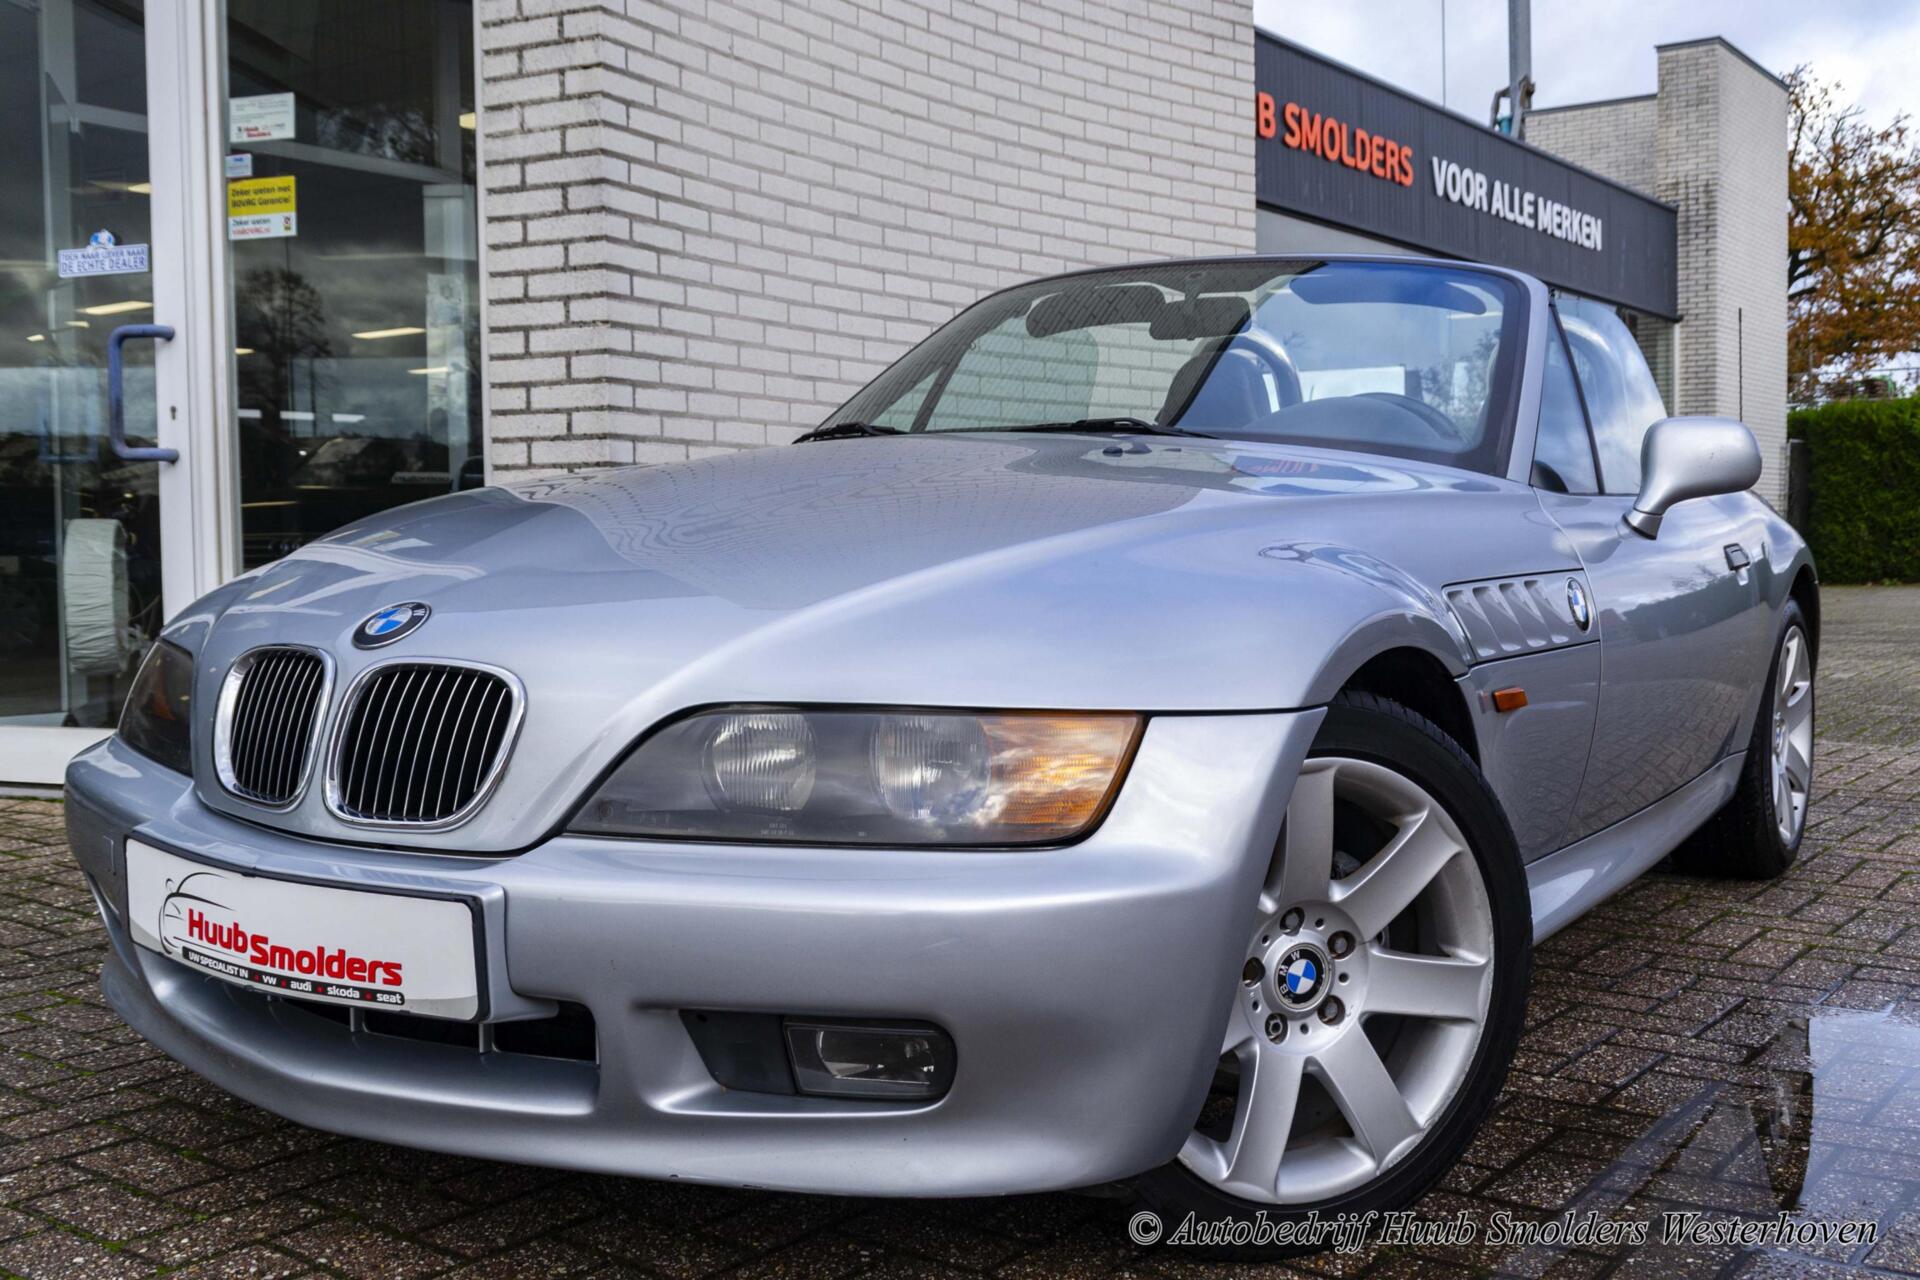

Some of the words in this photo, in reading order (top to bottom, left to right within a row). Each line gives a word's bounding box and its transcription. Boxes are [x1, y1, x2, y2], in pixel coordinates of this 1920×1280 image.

[1283, 101, 1414, 187] SMOLDERS
[1431, 155, 1489, 212] VOOR
[1491, 179, 1535, 229] ALLE
[1537, 195, 1603, 252] MERKEN
[62, 261, 73, 272] DE
[77, 259, 105, 272] ECHTE
[109, 256, 146, 270] DEALER
[188, 907, 248, 953] Huub
[249, 934, 402, 987] Smolders
[200, 953, 240, 976] SPECIALIST
[239, 968, 249, 979] IN
[290, 979, 312, 992] audi
[327, 985, 360, 999] skoda
[376, 992, 402, 1004] seat
